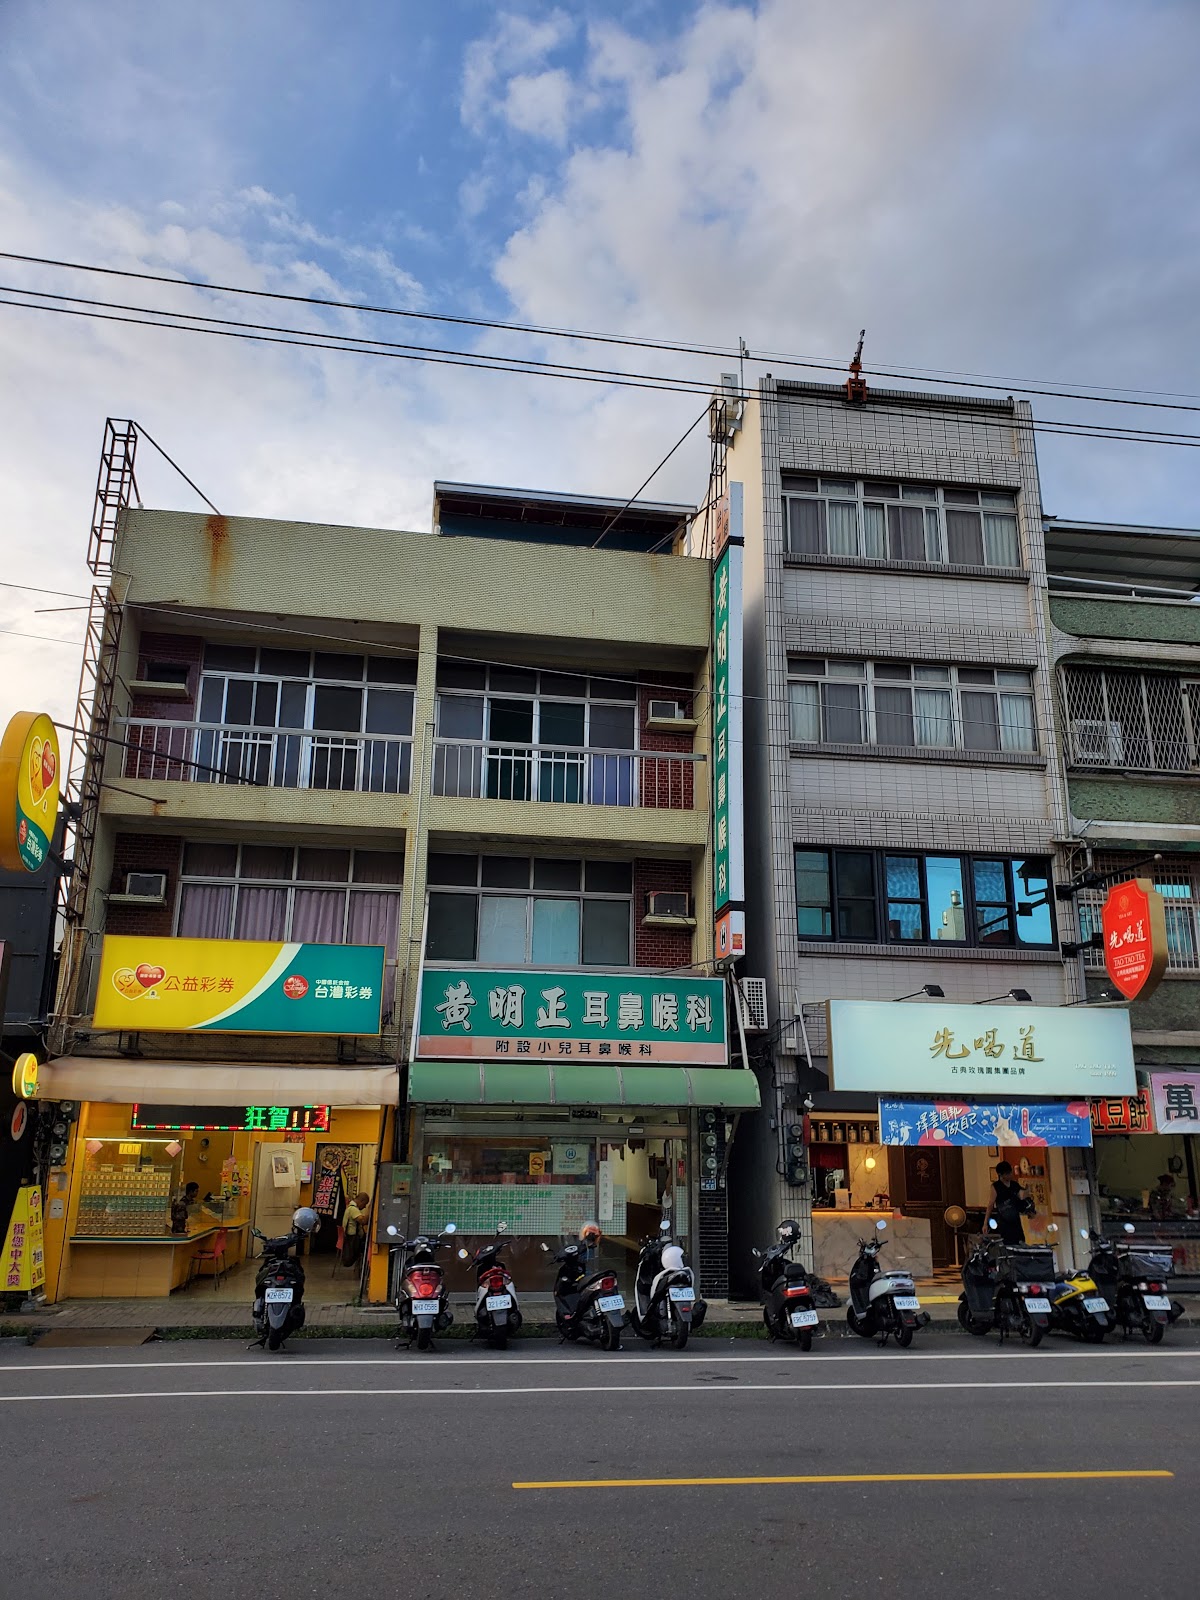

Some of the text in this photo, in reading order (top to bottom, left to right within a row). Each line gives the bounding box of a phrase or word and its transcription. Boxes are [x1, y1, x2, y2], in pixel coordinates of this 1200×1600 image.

[1109, 919, 1147, 950] 先喝道
[1114, 953, 1146, 967] TAO TAO TEA
[164, 975, 234, 994] 公益彩券
[314, 986, 373, 1000] 台灣彩券
[434, 979, 714, 1034] 黃明正耳鼻喉科
[495, 1040, 653, 1057] 附設小兒耳鼻喉科
[929, 1025, 1045, 1063] 先喝道
[951, 1066, 1026, 1076] 古典玫瑰園集團品牌
[1162, 1083, 1198, 1121] 萬
[7, 1223, 25, 1287] 祝您中大獎
